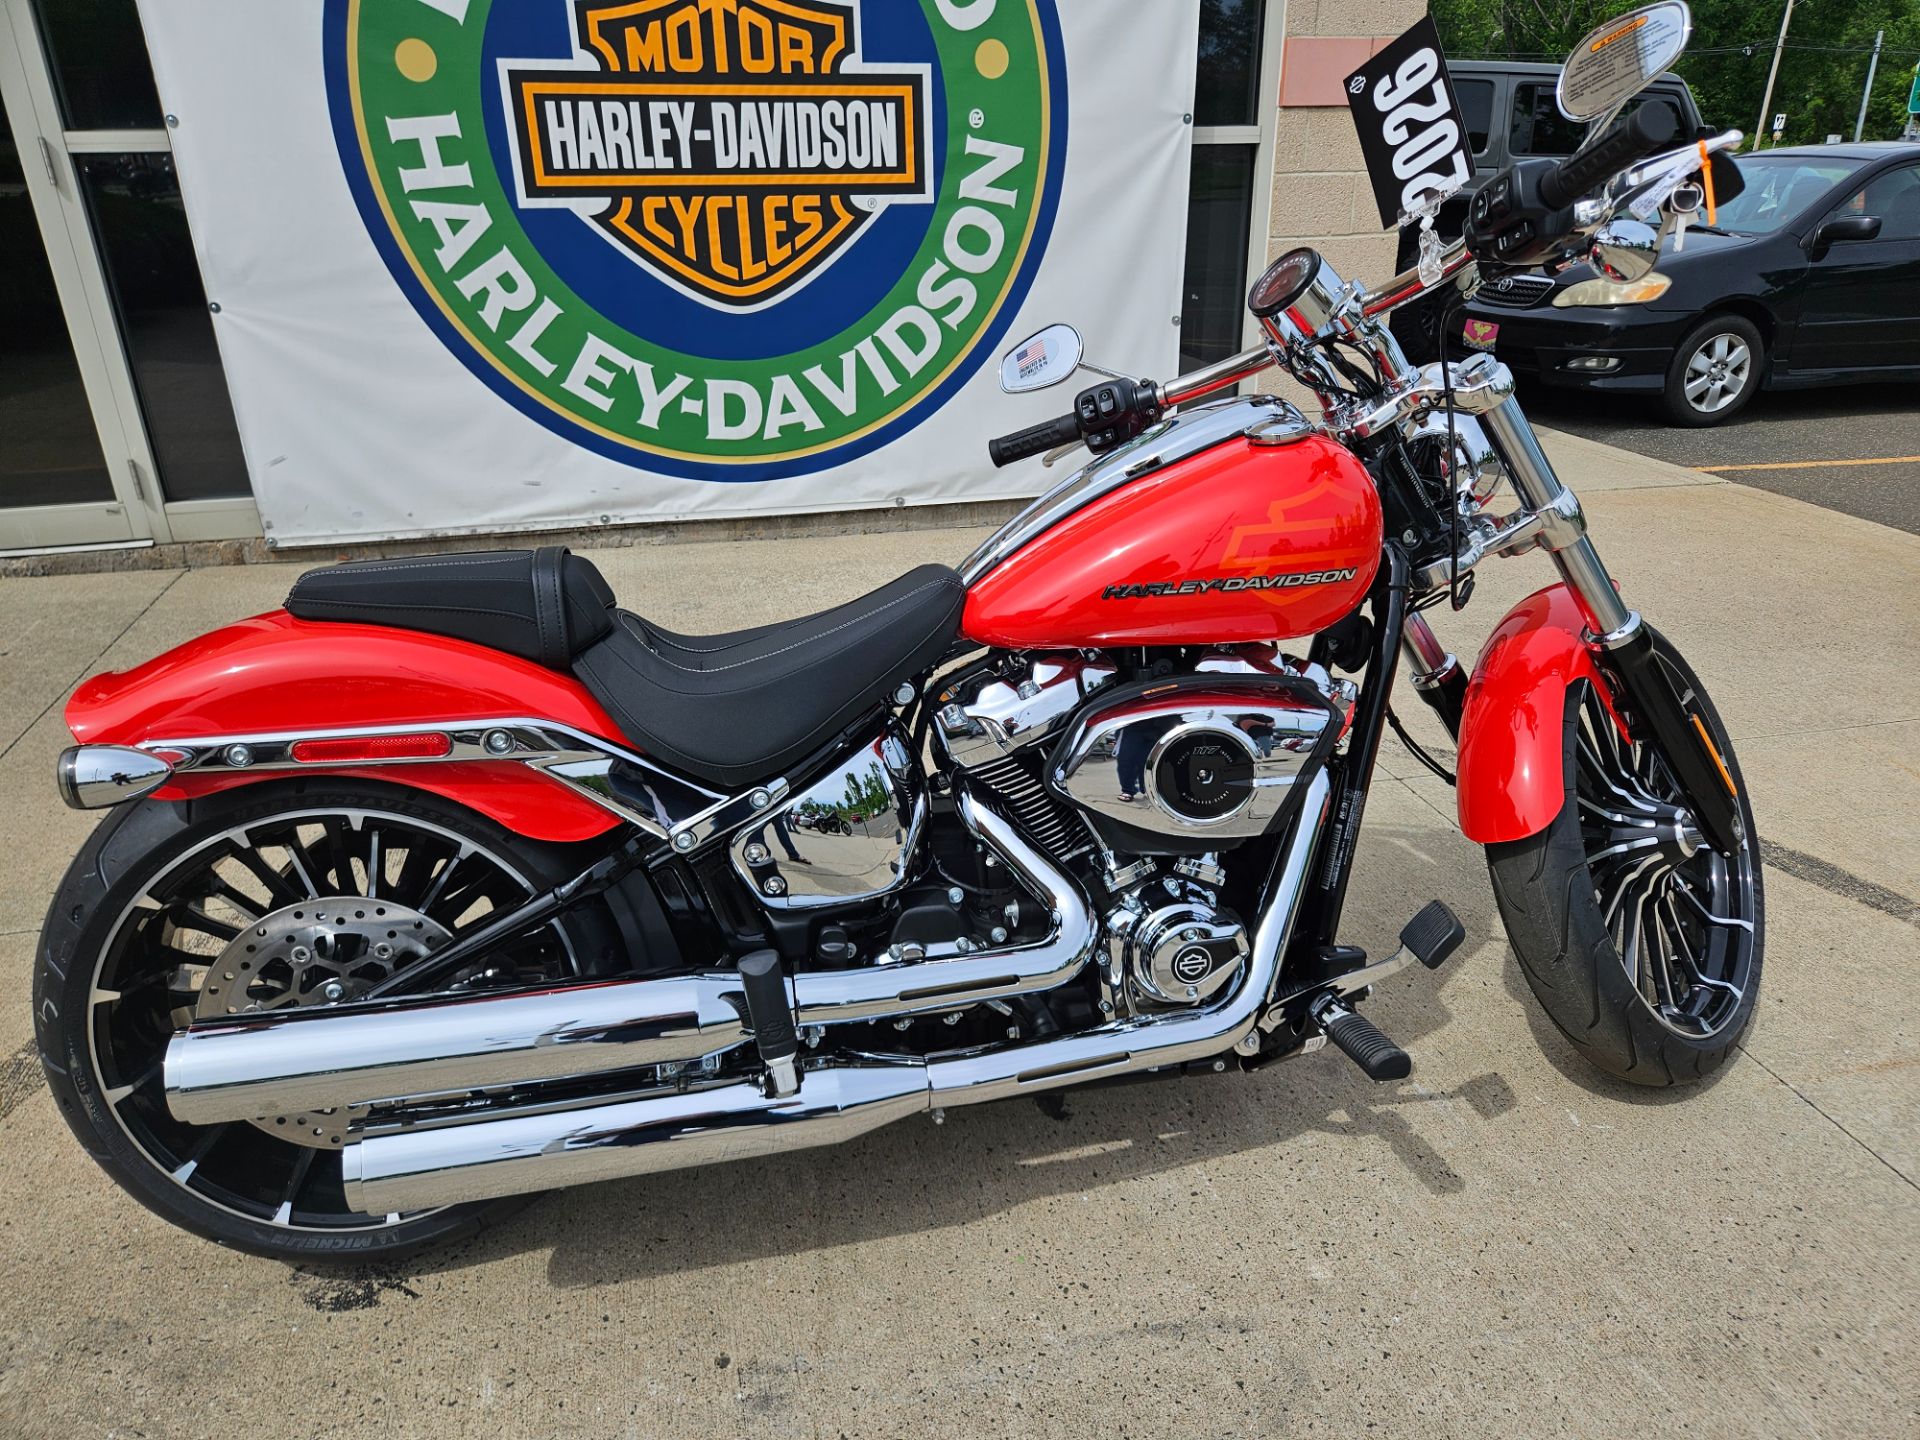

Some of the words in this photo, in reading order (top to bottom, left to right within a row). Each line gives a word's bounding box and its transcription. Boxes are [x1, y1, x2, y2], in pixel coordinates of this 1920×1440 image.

[624, 0, 818, 75] MOTOR
[544, 100, 898, 171] HARLEY-DAVIDSON
[1373, 47, 1471, 215] 2026
[641, 194, 824, 281] CYCLES
[1101, 568, 1359, 601] HARLEY-DAVIDSON
